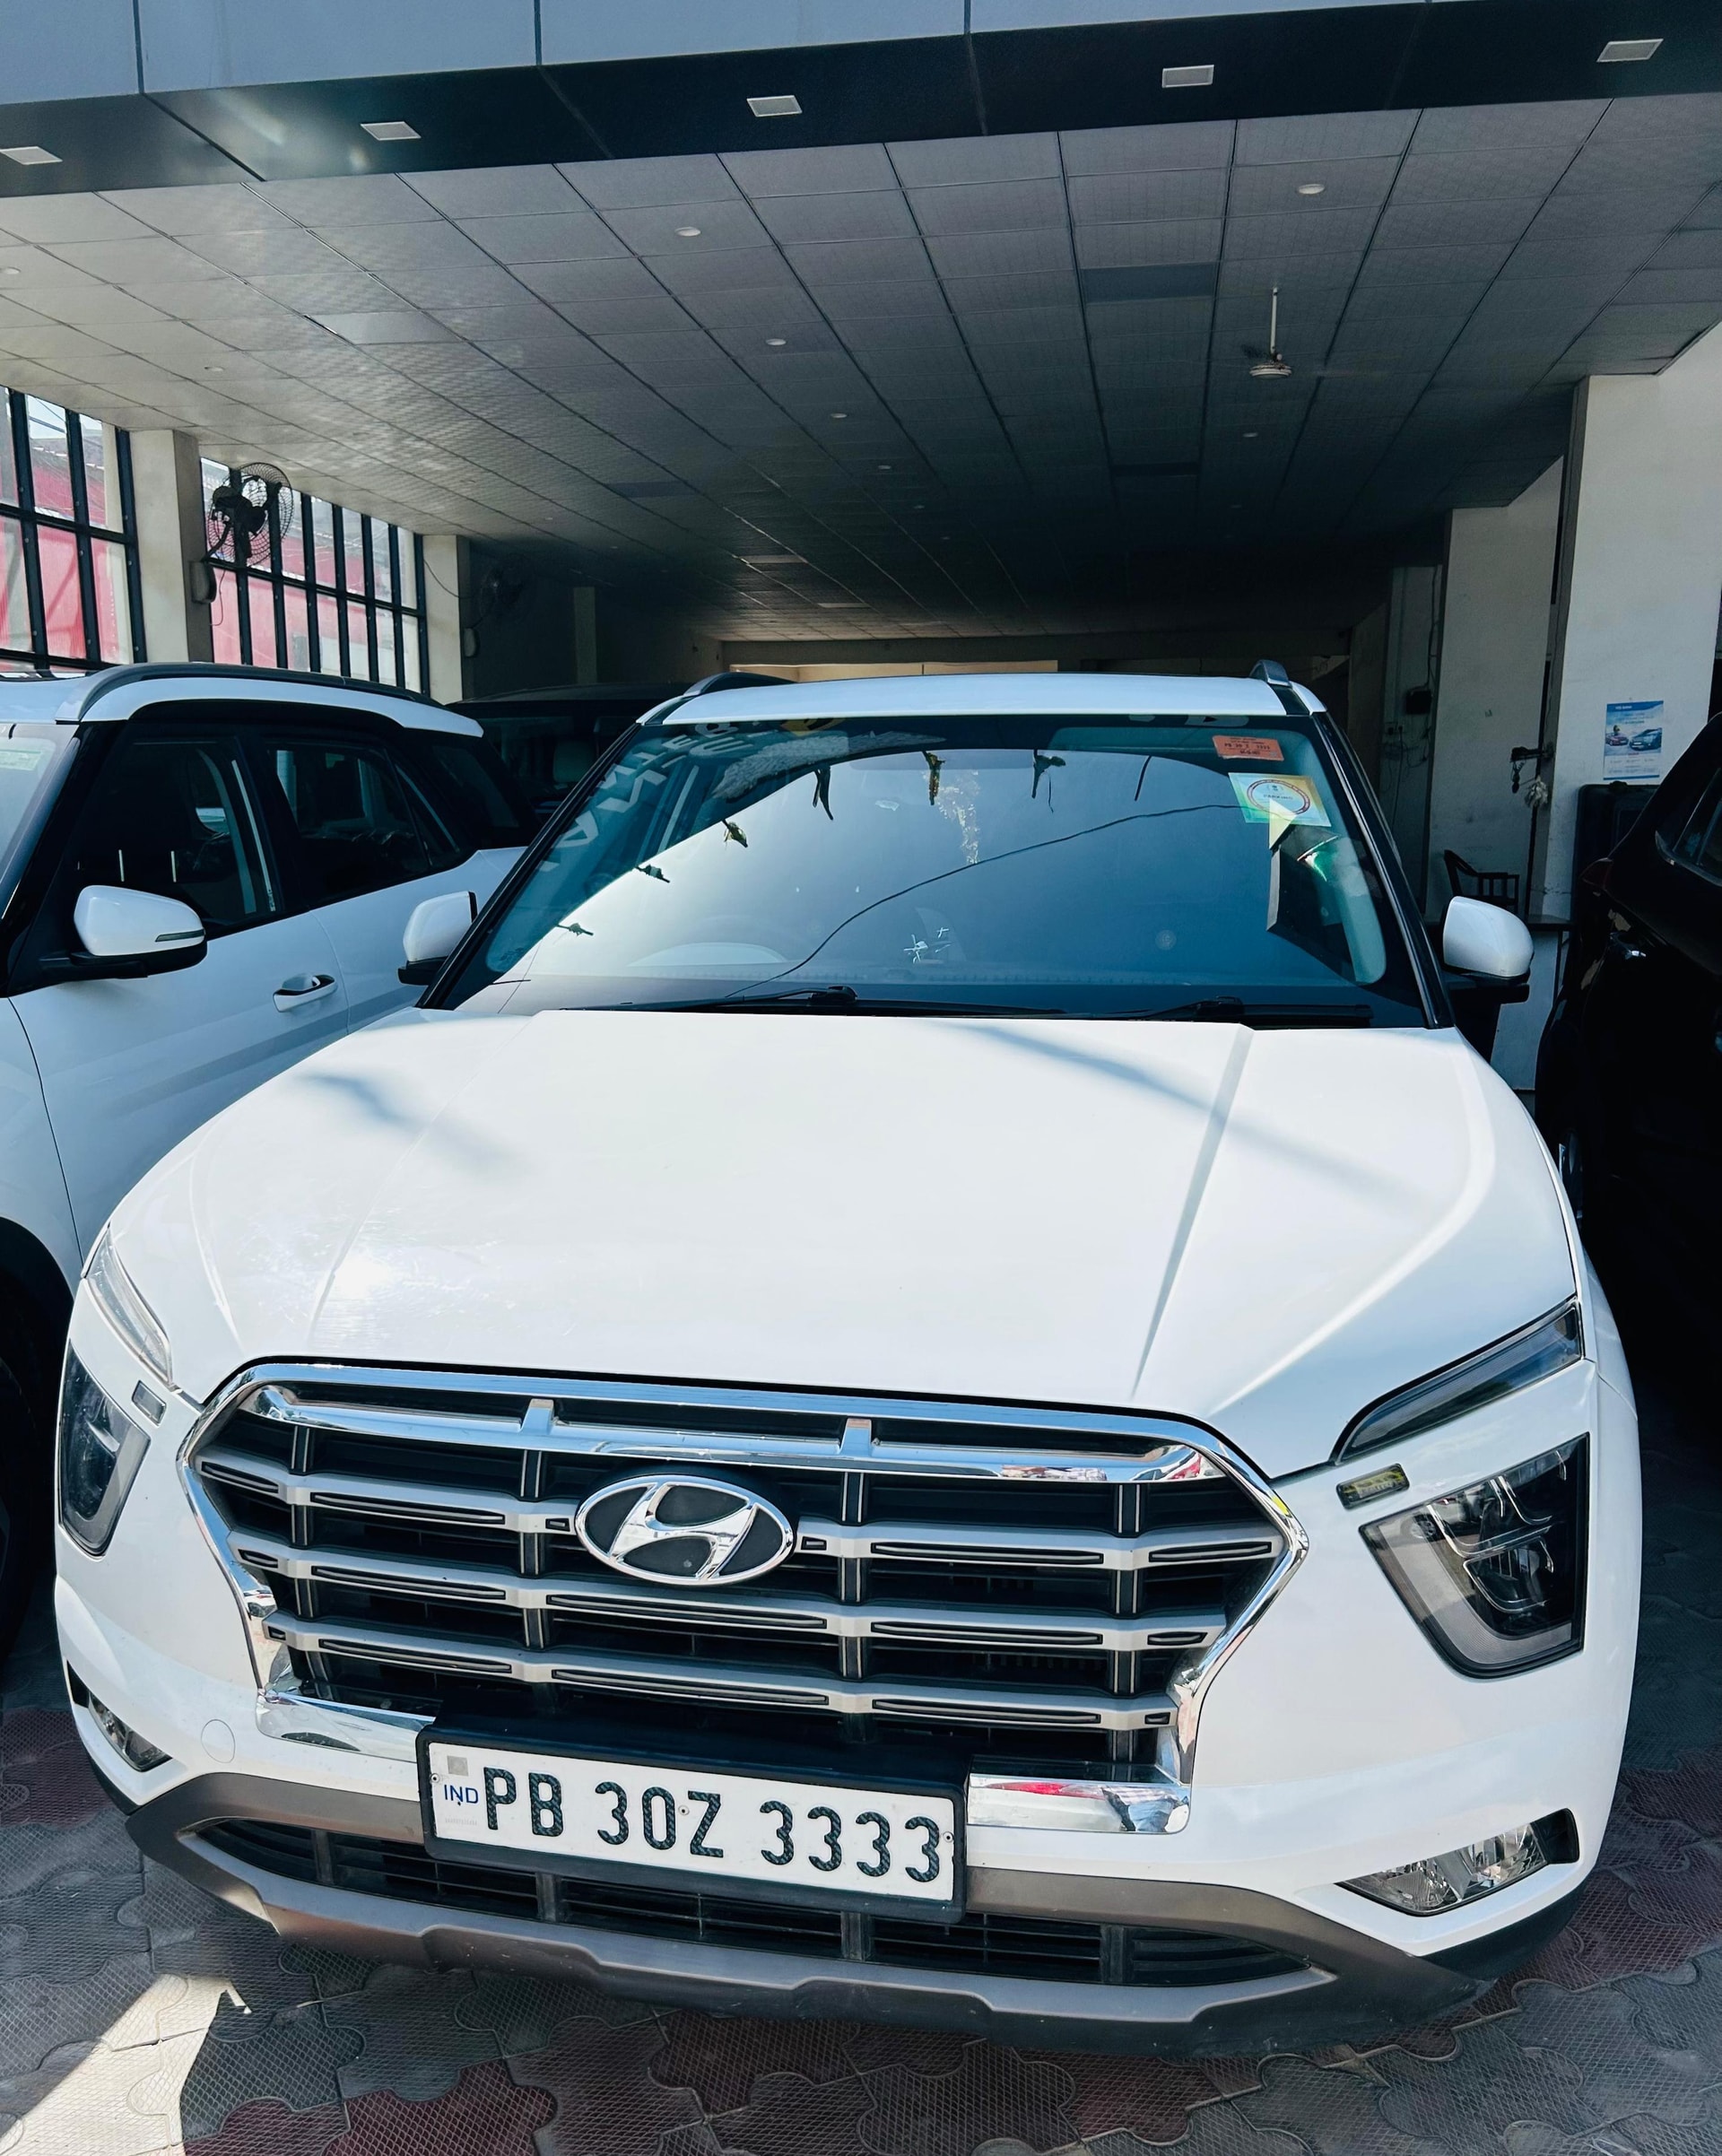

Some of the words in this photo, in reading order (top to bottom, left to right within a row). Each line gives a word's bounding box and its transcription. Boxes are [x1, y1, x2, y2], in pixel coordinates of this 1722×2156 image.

[444, 1784, 478, 1804] IND
[483, 1767, 564, 1838] PB
[595, 1781, 724, 1858] 30Z
[760, 1799, 941, 1882] 3333
